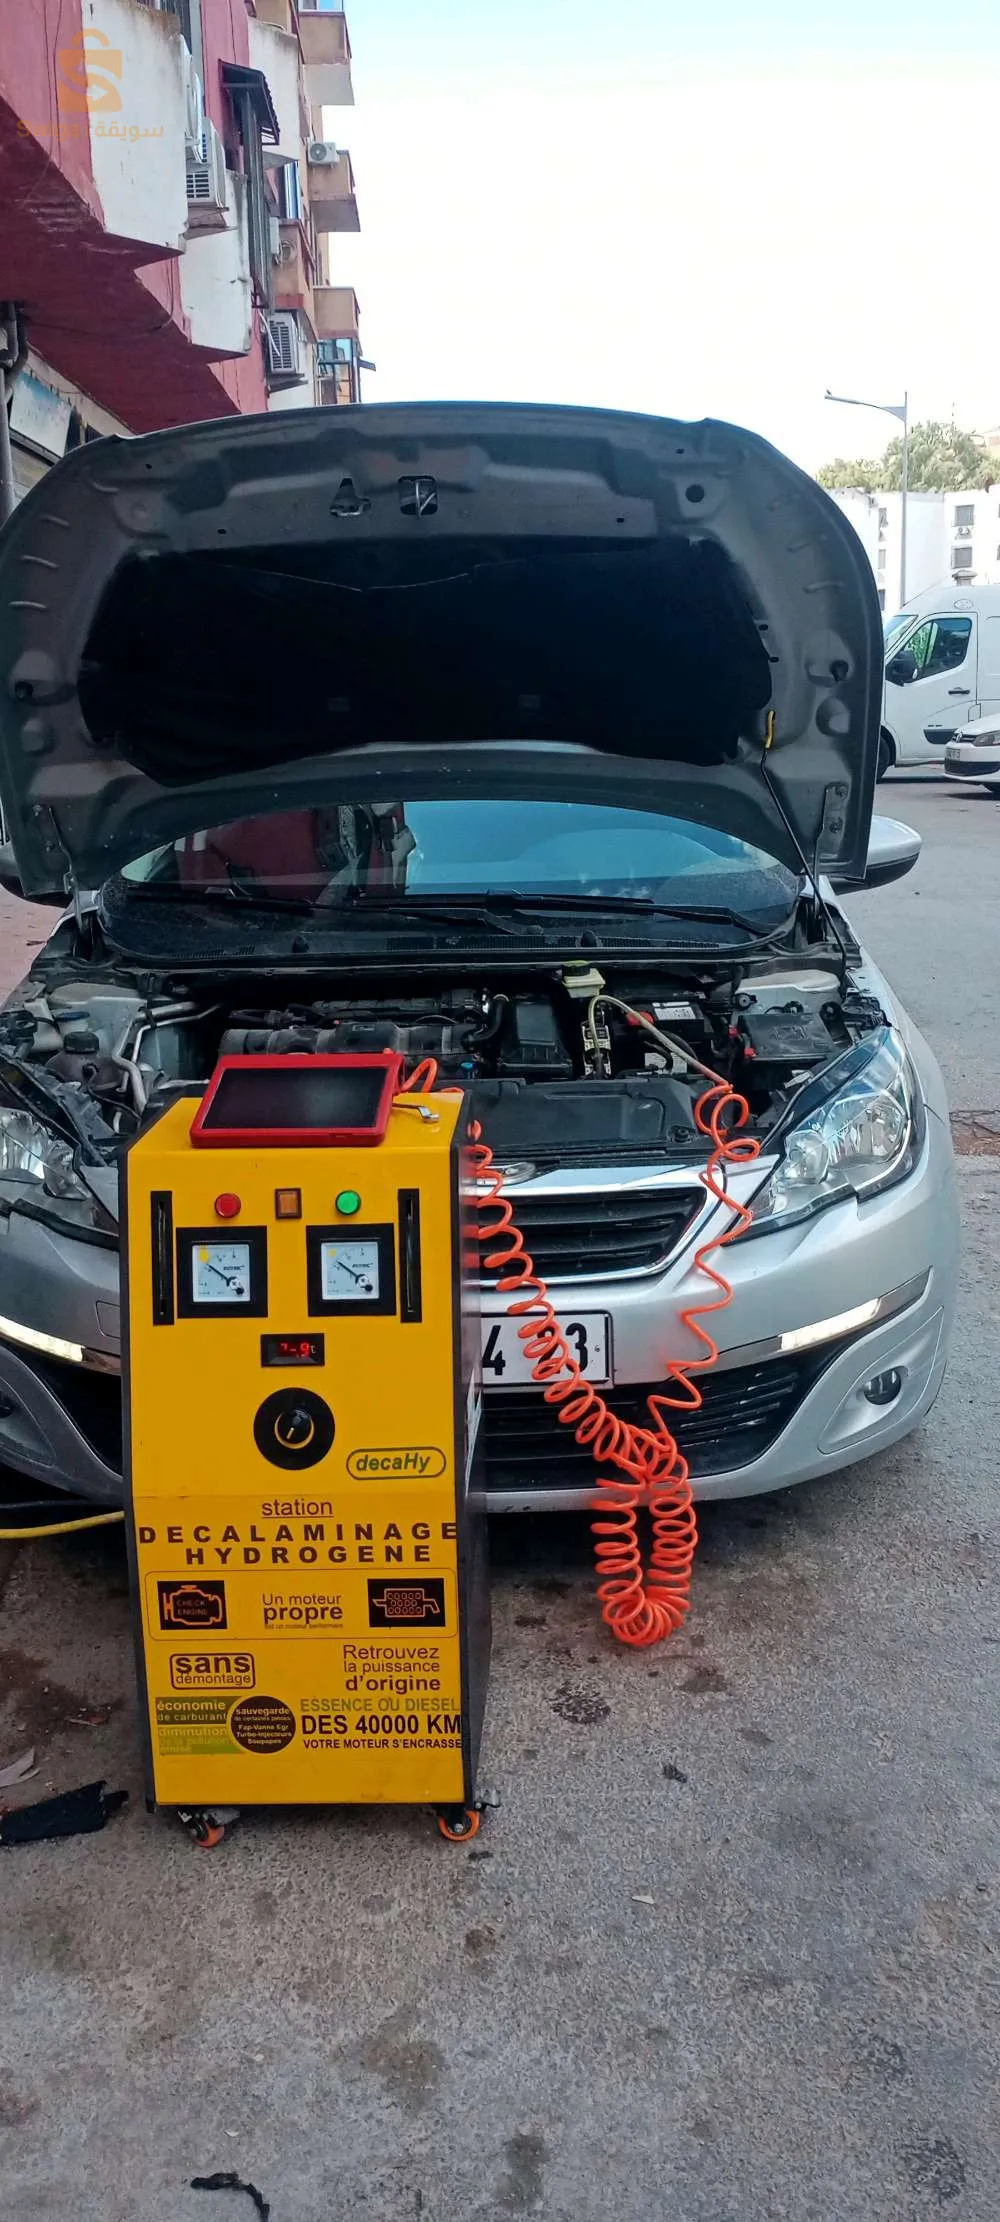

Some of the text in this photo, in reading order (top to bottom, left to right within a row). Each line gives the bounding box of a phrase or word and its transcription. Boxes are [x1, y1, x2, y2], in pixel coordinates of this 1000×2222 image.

[356, 1452, 430, 1473] decaHy
[261, 1500, 333, 1518] station
[139, 1522, 457, 1544] DECALAMINAGE
[186, 1546, 430, 1565] HYDROGENE
[263, 1593, 341, 1605] Un moteur
[264, 1607, 343, 1624] propre
[343, 1645, 440, 1659] Retrouvez
[176, 1656, 250, 1673] sans
[344, 1661, 440, 1674] la puissance
[157, 1701, 226, 1711] économie
[235, 1707, 290, 1716] sauvegarde
[300, 1698, 373, 1712] ESSENCE
[405, 1698, 459, 1711] DIESEL
[301, 1714, 460, 1734] DES 40000 KM
[303, 1739, 340, 1749] VOTRE
[343, 1739, 389, 1749] MOTEUR
